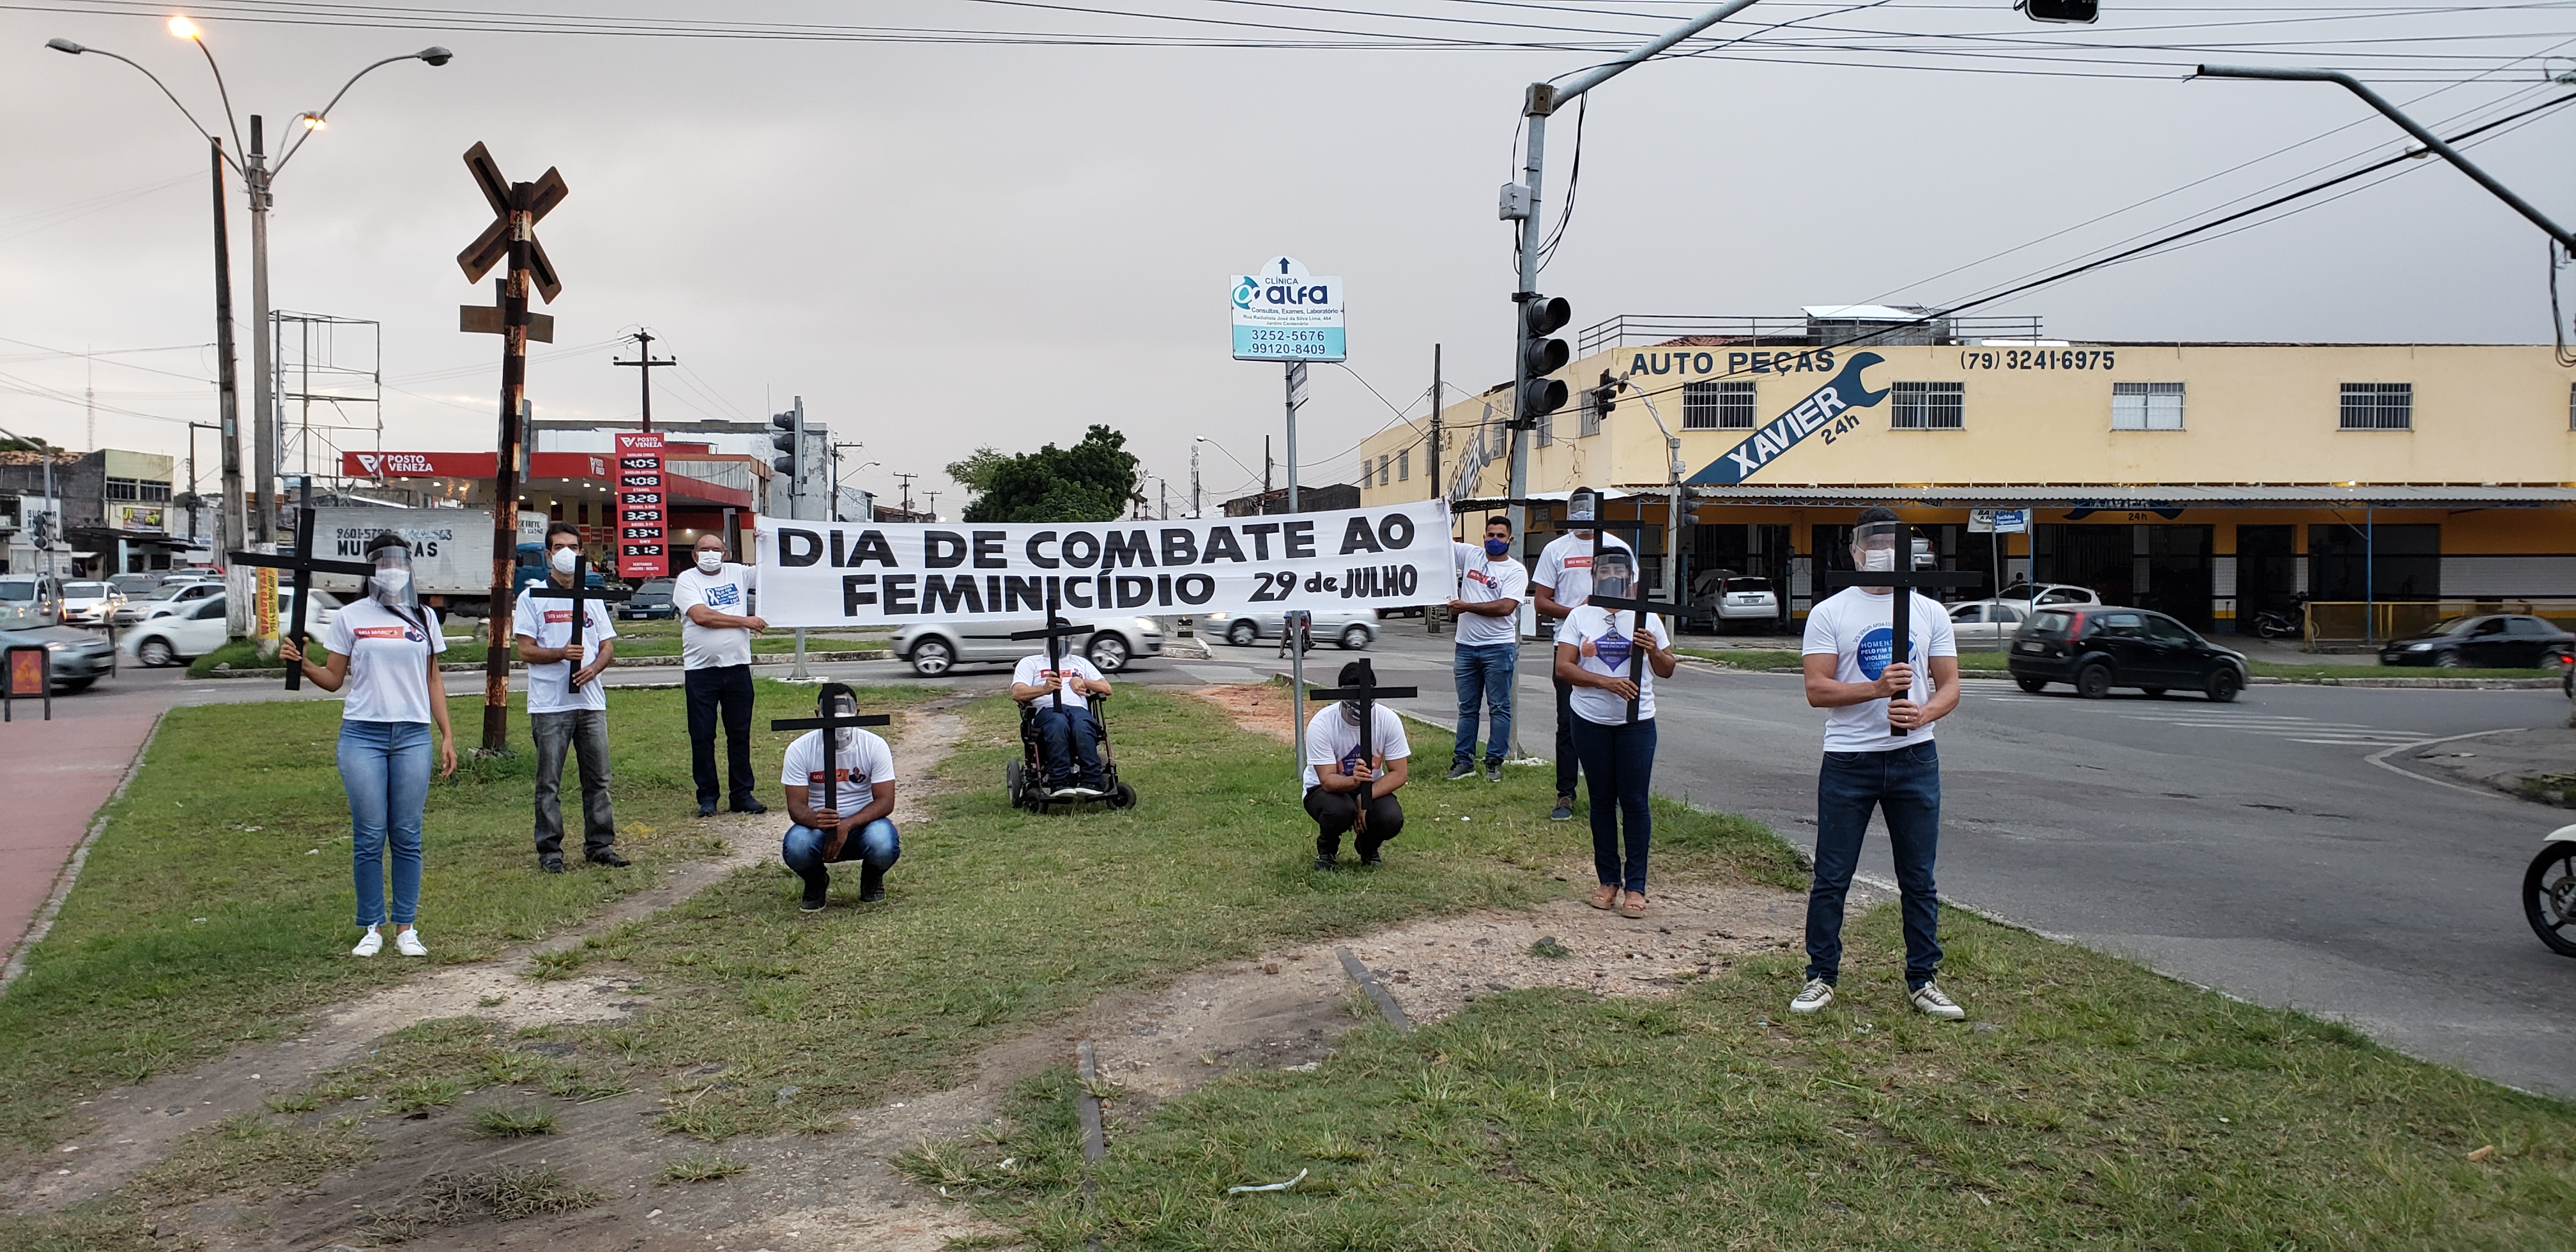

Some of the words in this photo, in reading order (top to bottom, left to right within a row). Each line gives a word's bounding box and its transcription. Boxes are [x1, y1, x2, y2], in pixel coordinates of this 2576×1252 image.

[1265, 276, 1298, 285] CLÍNICA
[1266, 286, 1328, 305] alfa
[1252, 330, 1324, 341] 3252-5676
[1252, 343, 1325, 355] 99120-8409
[1630, 352, 1713, 376] AUTO
[1729, 351, 1835, 376] PEÇAS
[1960, 351, 2000, 370] (79)
[1727, 386, 1848, 478] XAVIER
[1820, 413, 1860, 446] 24h
[387, 455, 425, 463] POSTO
[388, 463, 433, 471] VENEZA
[337, 540, 438, 557] MUAS
[778, 528, 899, 567] DIA
[924, 530, 1008, 569] DE
[1025, 521, 1316, 569] COMBATE
[1339, 513, 1414, 555] AO
[843, 569, 1215, 617] FEMINICÍDIO
[1247, 571, 1297, 602] 29
[1304, 572, 1338, 592] de
[1340, 564, 1417, 599] JULHO
